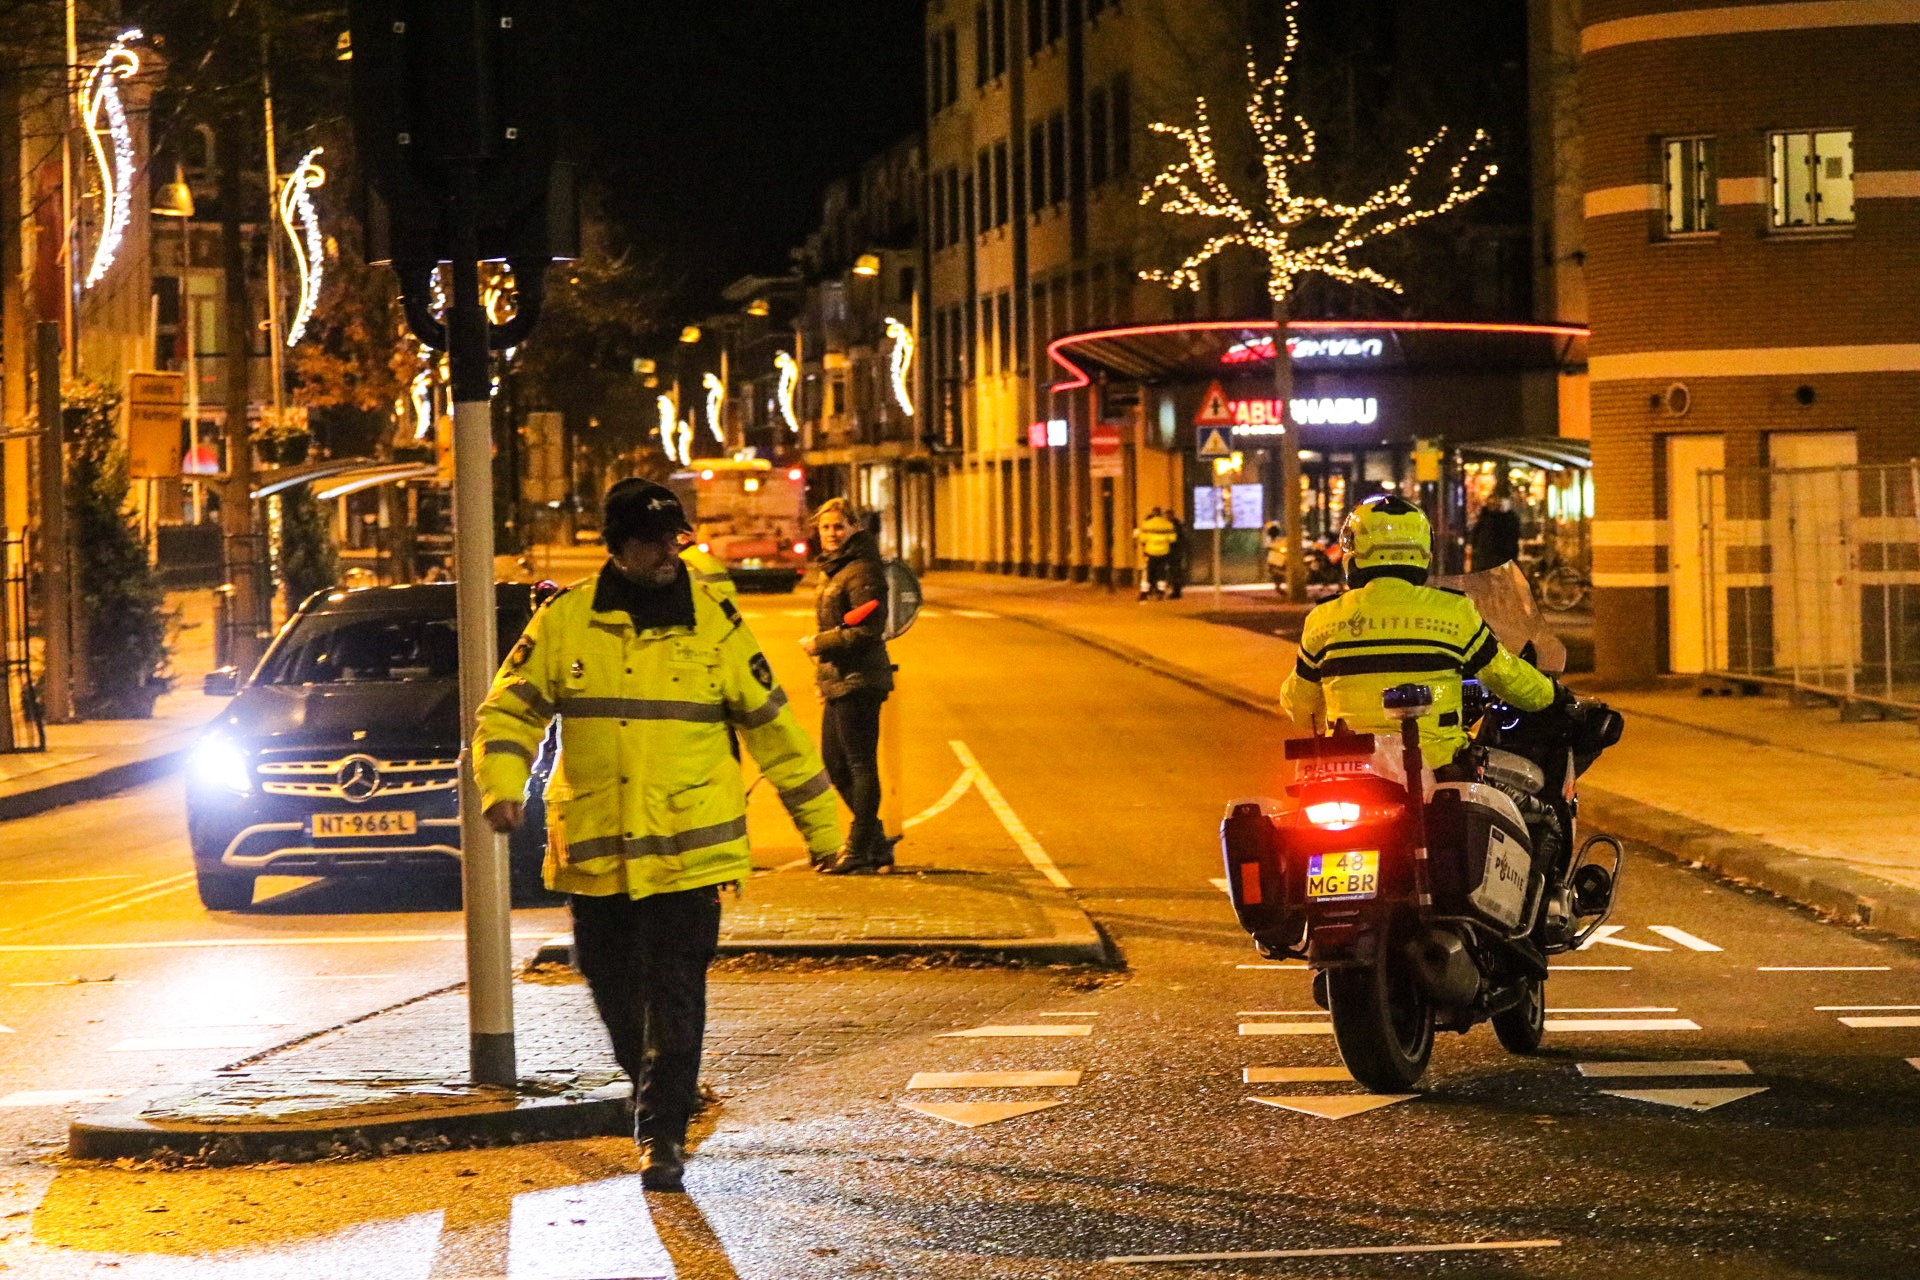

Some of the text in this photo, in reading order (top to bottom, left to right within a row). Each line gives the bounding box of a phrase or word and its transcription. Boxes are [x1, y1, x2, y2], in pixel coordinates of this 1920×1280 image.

[1228, 400, 1283, 424] ABU
[1337, 613, 1424, 637] POLITIE
[320, 814, 408, 833] NT-966-L
[1336, 853, 1363, 872] 48
[1495, 852, 1524, 892] POLITIE
[1309, 873, 1374, 895] MG-BR
